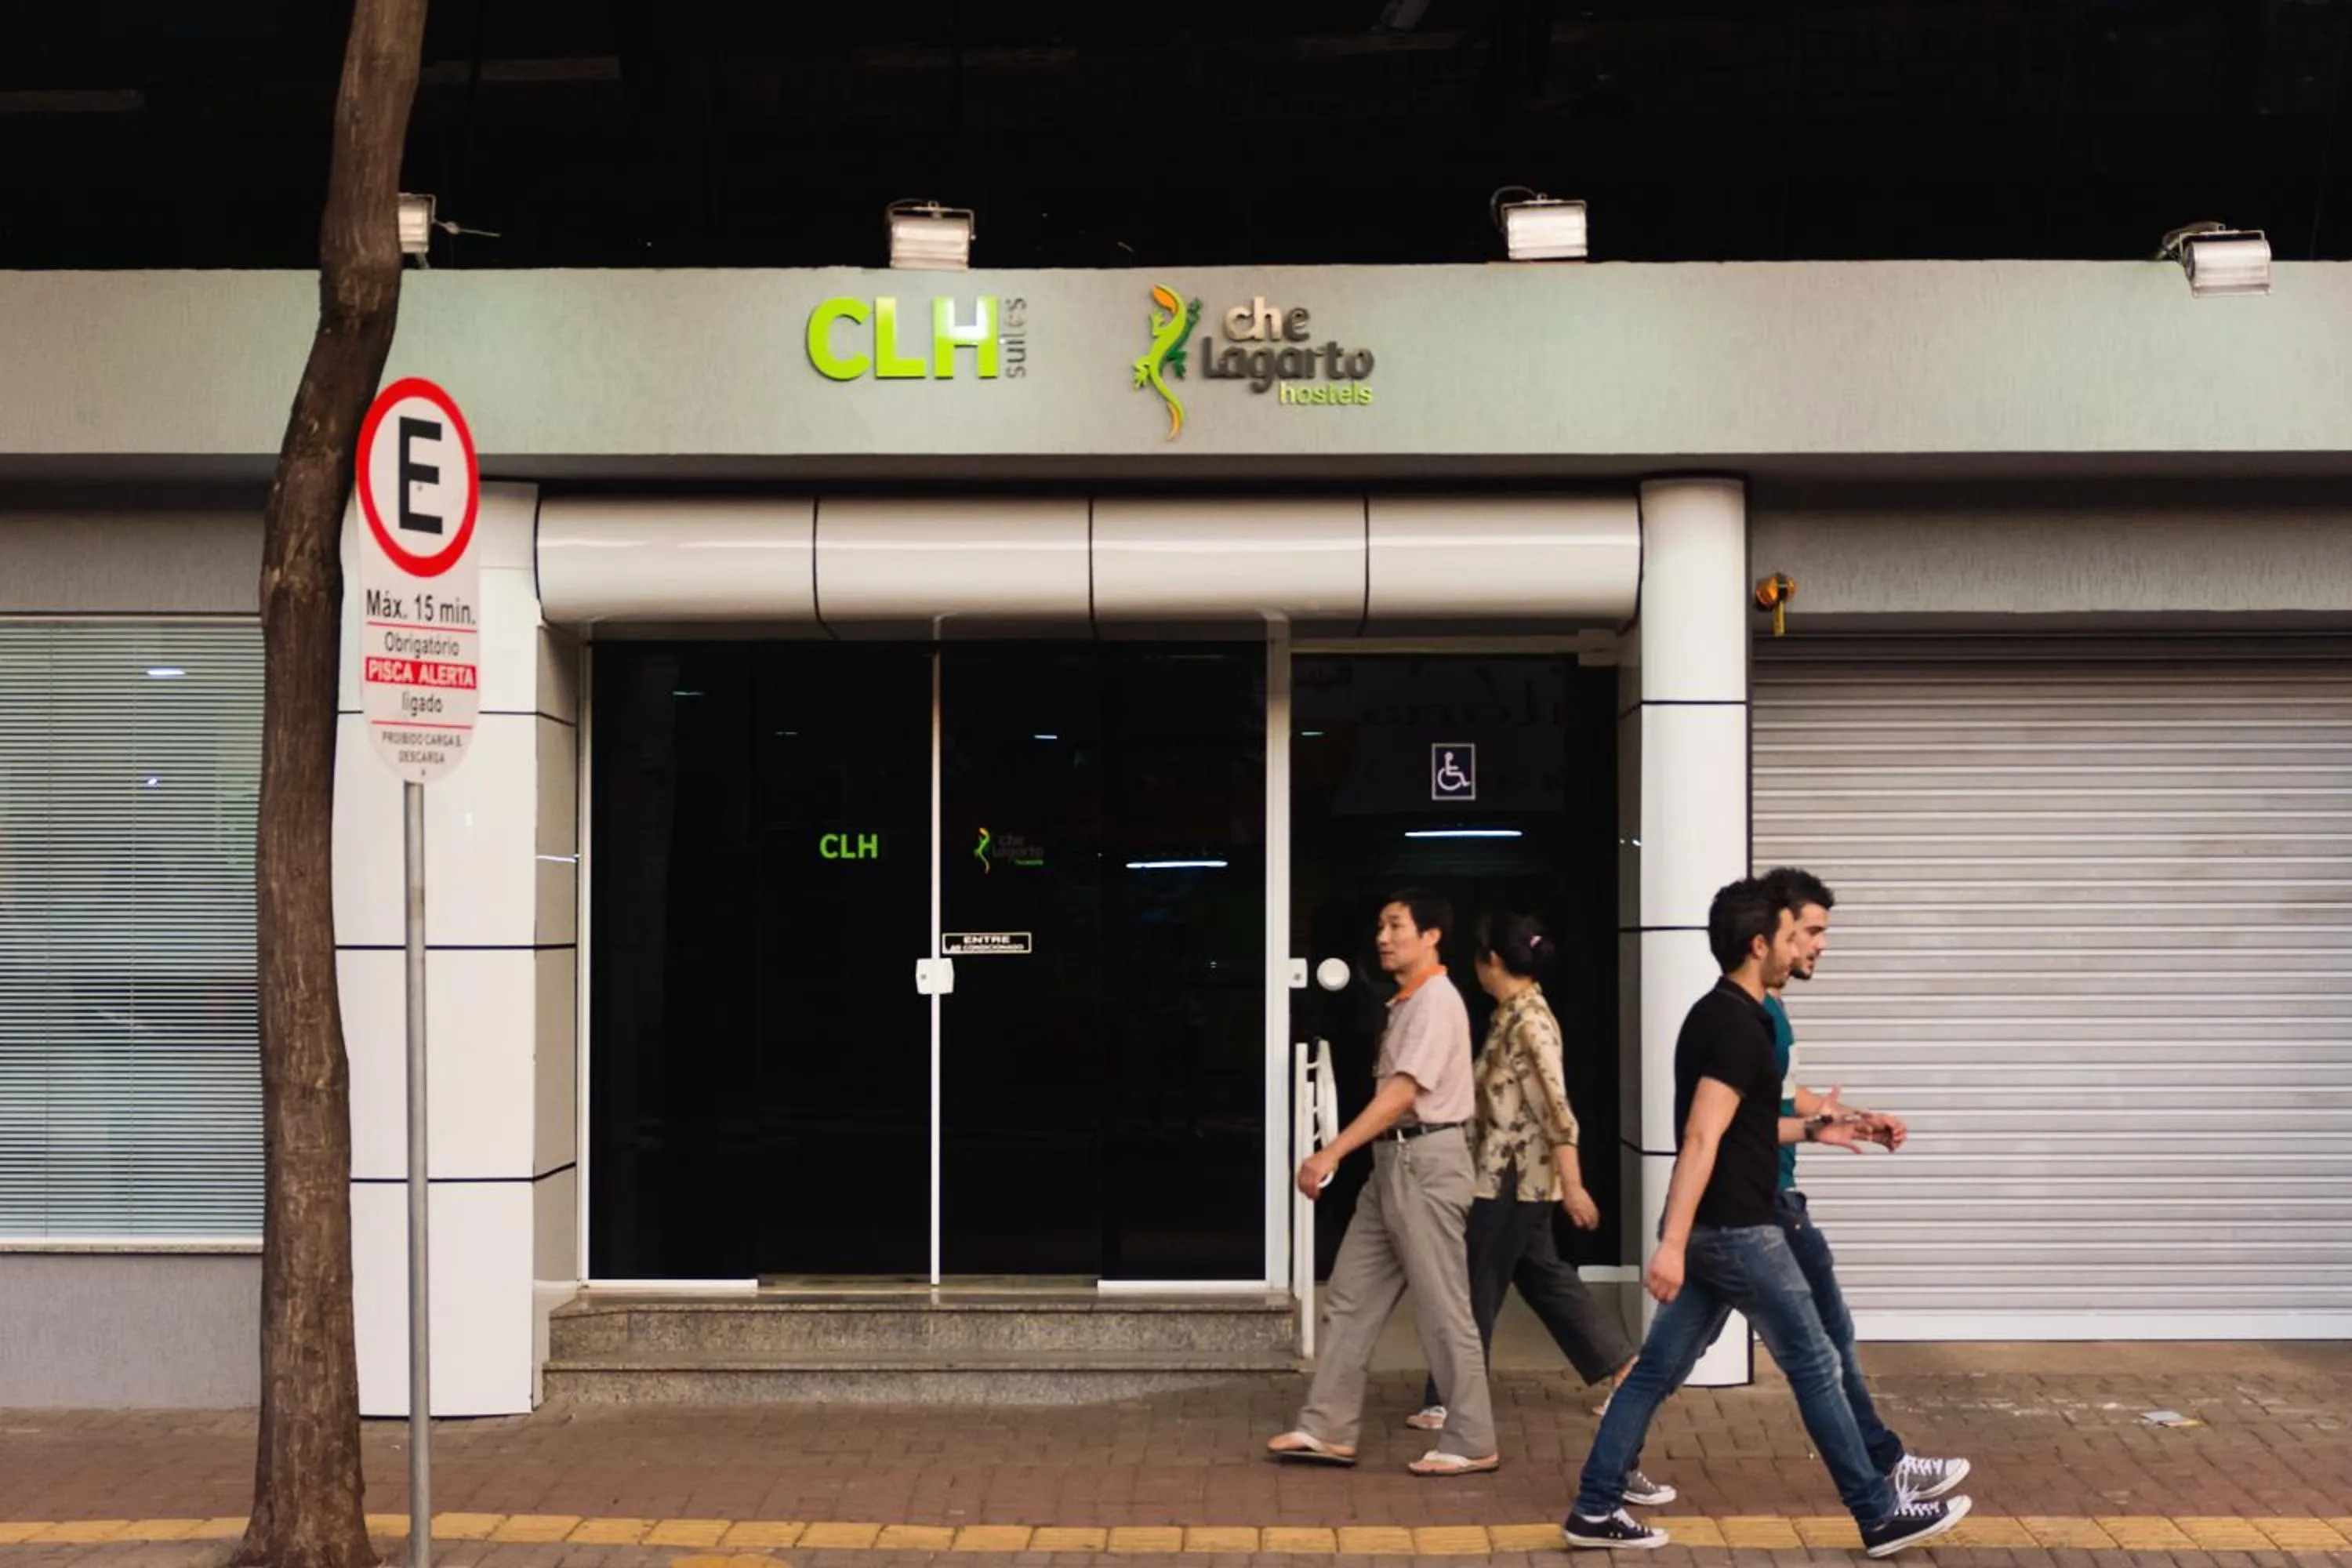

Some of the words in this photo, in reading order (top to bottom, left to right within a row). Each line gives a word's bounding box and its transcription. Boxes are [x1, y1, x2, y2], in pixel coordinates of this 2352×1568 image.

[1222, 296, 1310, 342] che
[805, 296, 999, 381] CLH
[1001, 297, 1027, 379] suites
[1200, 336, 1375, 394] Lagarto
[1279, 381, 1374, 407] hostels
[399, 416, 443, 535] E
[366, 589, 408, 619] Máx.
[415, 593, 434, 622] 15
[440, 597, 477, 625] min.
[384, 631, 460, 659] Obrigatório
[368, 659, 414, 683] PISCA
[418, 663, 475, 688] ALERTA
[402, 691, 444, 717] ligado
[819, 833, 878, 859] CLH
[963, 935, 1011, 944] ENTRE
